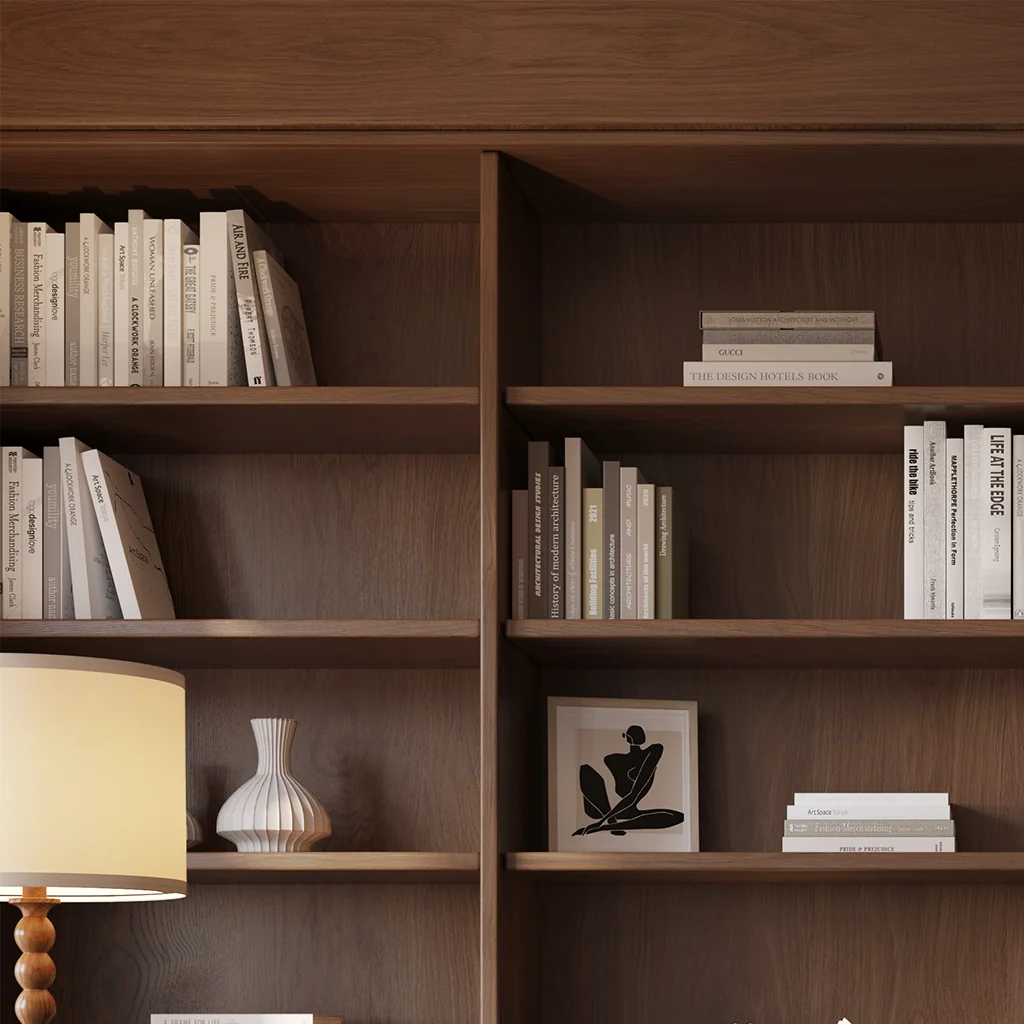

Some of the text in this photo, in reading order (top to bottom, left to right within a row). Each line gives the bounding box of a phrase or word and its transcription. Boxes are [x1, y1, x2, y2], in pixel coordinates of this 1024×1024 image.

[82, 241, 90, 273] CLOCKWORK
[232, 224, 250, 280] AIR AND FIRE
[14, 248, 24, 292] BUSINESS
[33, 254, 44, 282] Fashion
[66, 256, 80, 298] youmility
[186, 266, 196, 275] THE
[258, 264, 270, 293] Clockwork
[186, 276, 196, 293] GREAT
[30, 284, 44, 337] Merchandising
[186, 294, 196, 314] GATSBY
[263, 294, 274, 316] Orange
[14, 294, 24, 344] RESEARCH
[243, 299, 260, 356] RUPERT THOMSON
[32, 342, 40, 355] James
[70, 342, 78, 366] author
[100, 331, 110, 354] Harper
[690, 372, 839, 381] THE DESIGN HOTELS BOOK
[909, 449, 918, 495] ride the bike
[991, 435, 1004, 516] LIFE AT THE EDGE
[9, 481, 20, 511] Fashion
[65, 468, 77, 526] CLOCKWORK ORANGE
[92, 474, 104, 503] Art Space
[5, 514, 20, 572] Merchandising
[46, 484, 59, 603] youmility author
[550, 475, 561, 618] History of modern architecture
[660, 532, 668, 556] Drawing
[589, 505, 599, 616] Building Facilities 2021
[7, 577, 16, 592] James
[609, 577, 617, 604] concepts
[814, 823, 840, 832] Fashion
[842, 823, 892, 835] Merchandising
